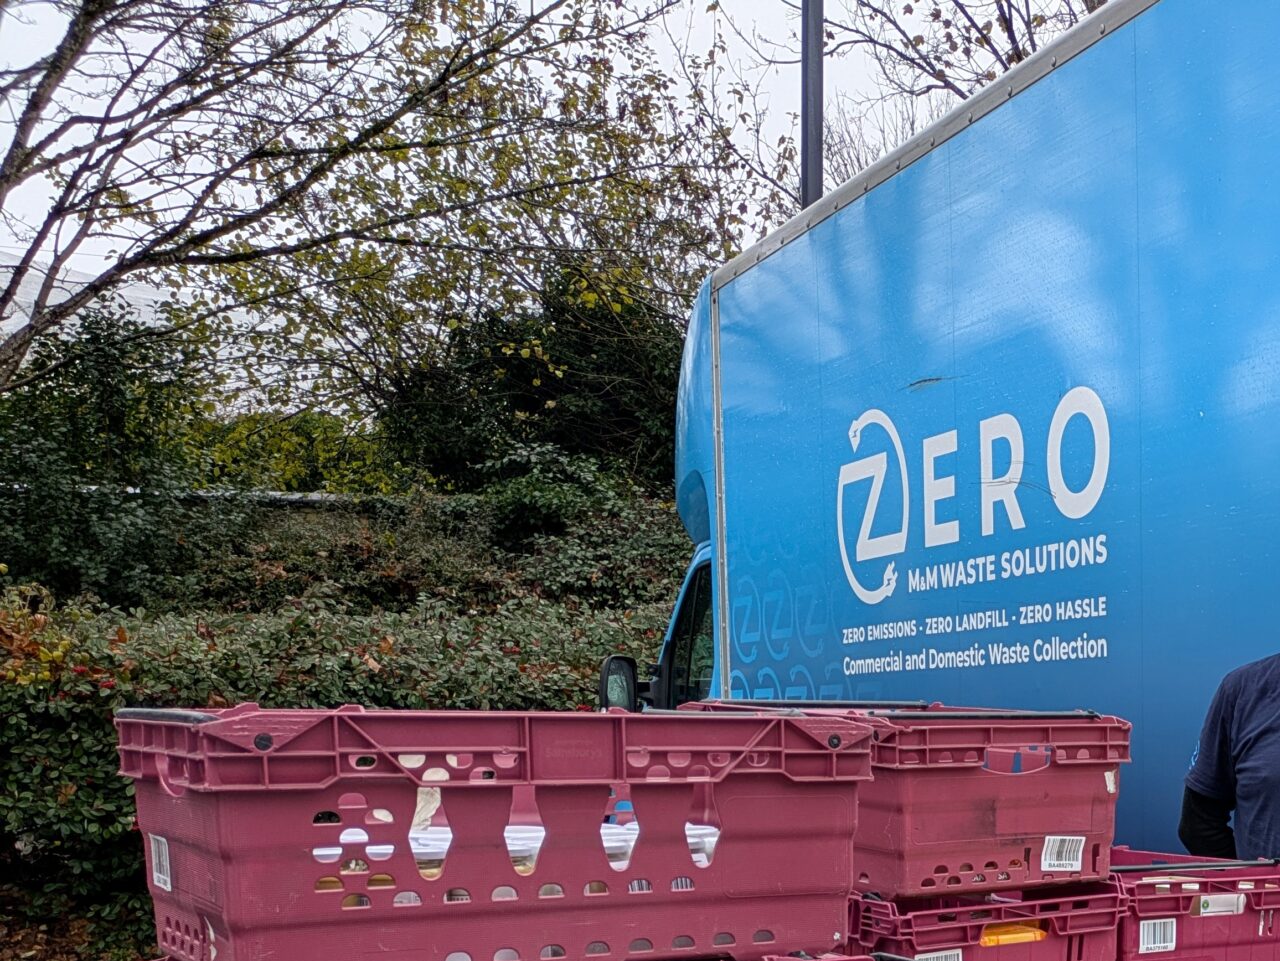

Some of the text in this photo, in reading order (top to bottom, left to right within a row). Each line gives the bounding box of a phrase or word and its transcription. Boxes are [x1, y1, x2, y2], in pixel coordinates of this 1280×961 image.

[837, 386, 1110, 602] ZERO
[908, 534, 1108, 593] M&M WASTE SOLUTIONS
[842, 596, 1107, 644] ZERO EMISSIONS ZERO LANDFILL ZERO HASSLE
[843, 633, 1108, 676] Commercial and Domestic Waste Collection
